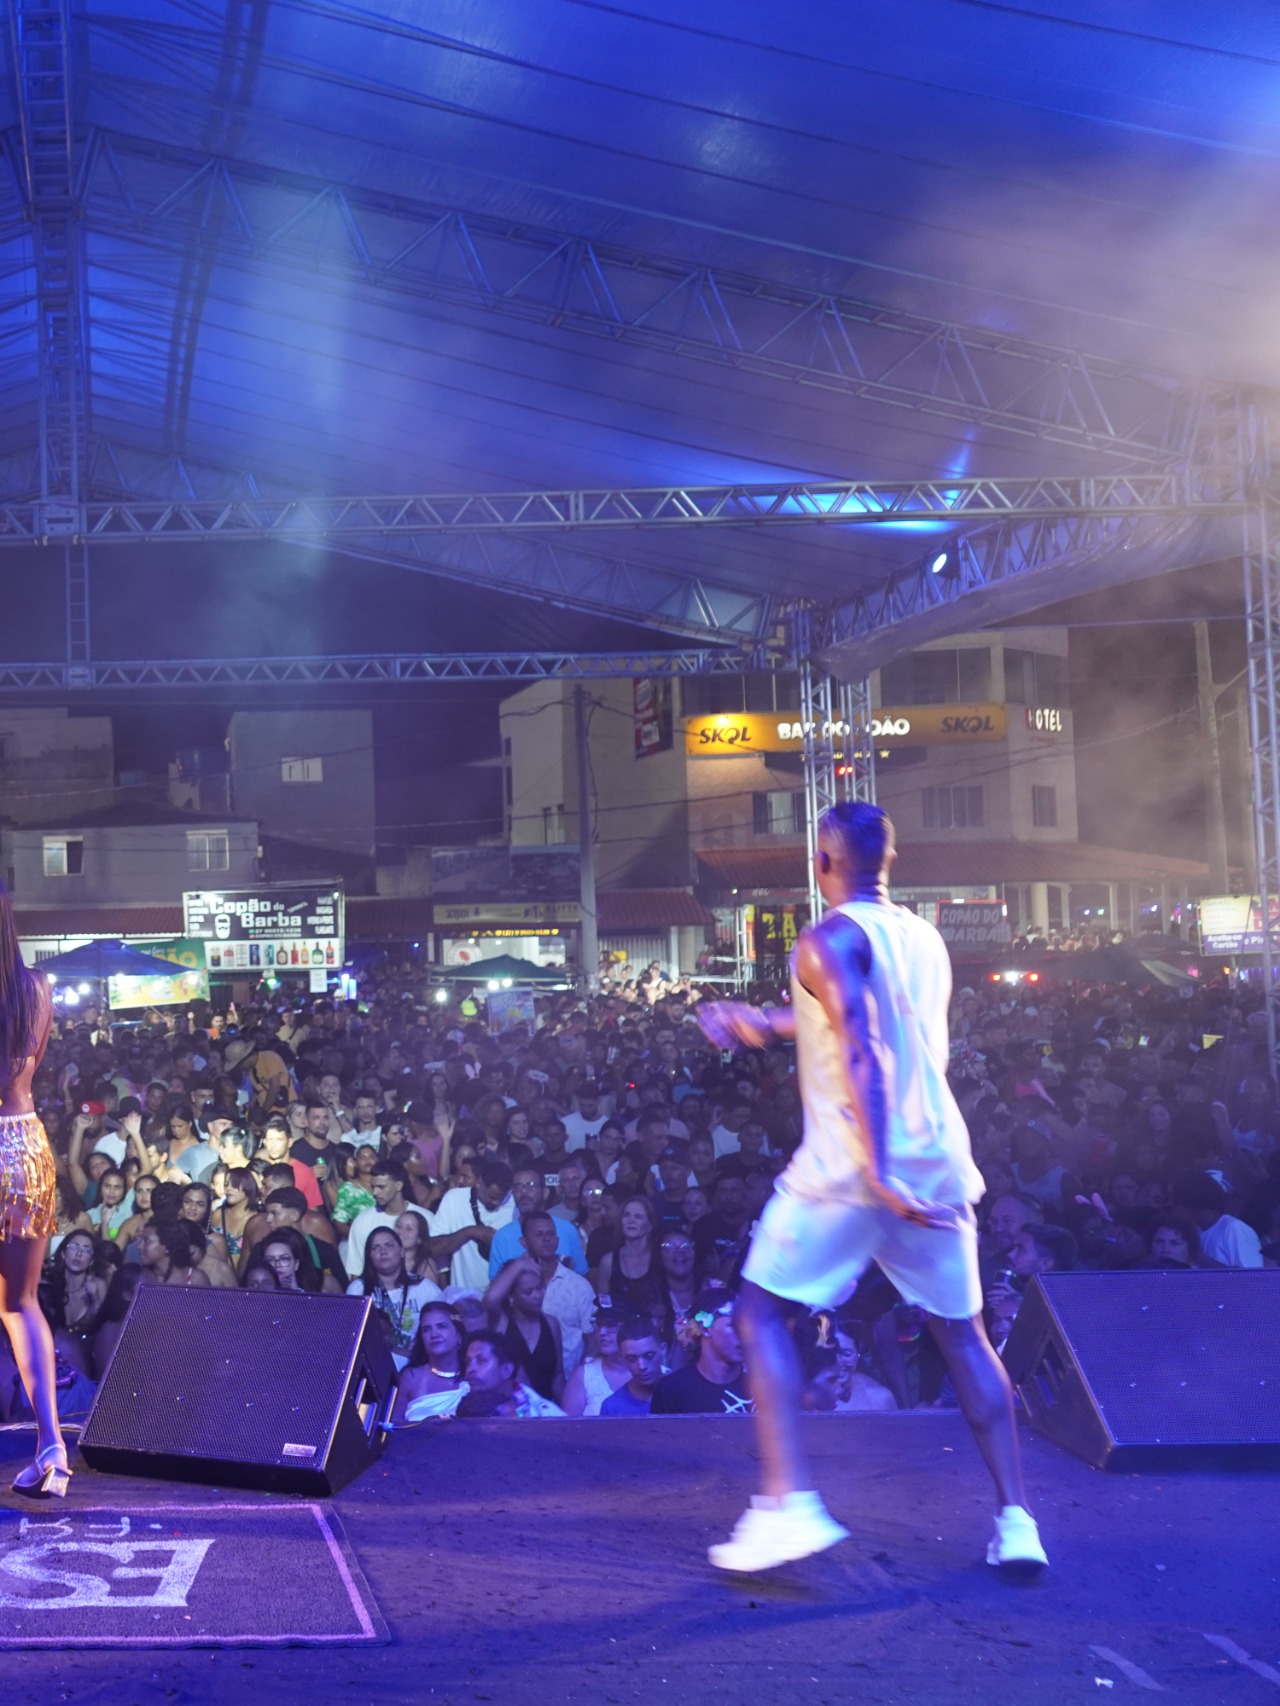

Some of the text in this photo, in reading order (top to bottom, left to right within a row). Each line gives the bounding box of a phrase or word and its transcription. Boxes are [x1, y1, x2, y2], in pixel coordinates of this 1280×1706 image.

[854, 715, 910, 736] OÃO
[941, 716, 994, 733] SKOL
[699, 727, 751, 744] SKOL
[210, 897, 271, 916] Copão
[241, 912, 302, 928] Barba
[983, 908, 1000, 923] DO
[1212, 941, 1239, 949] Cartão
